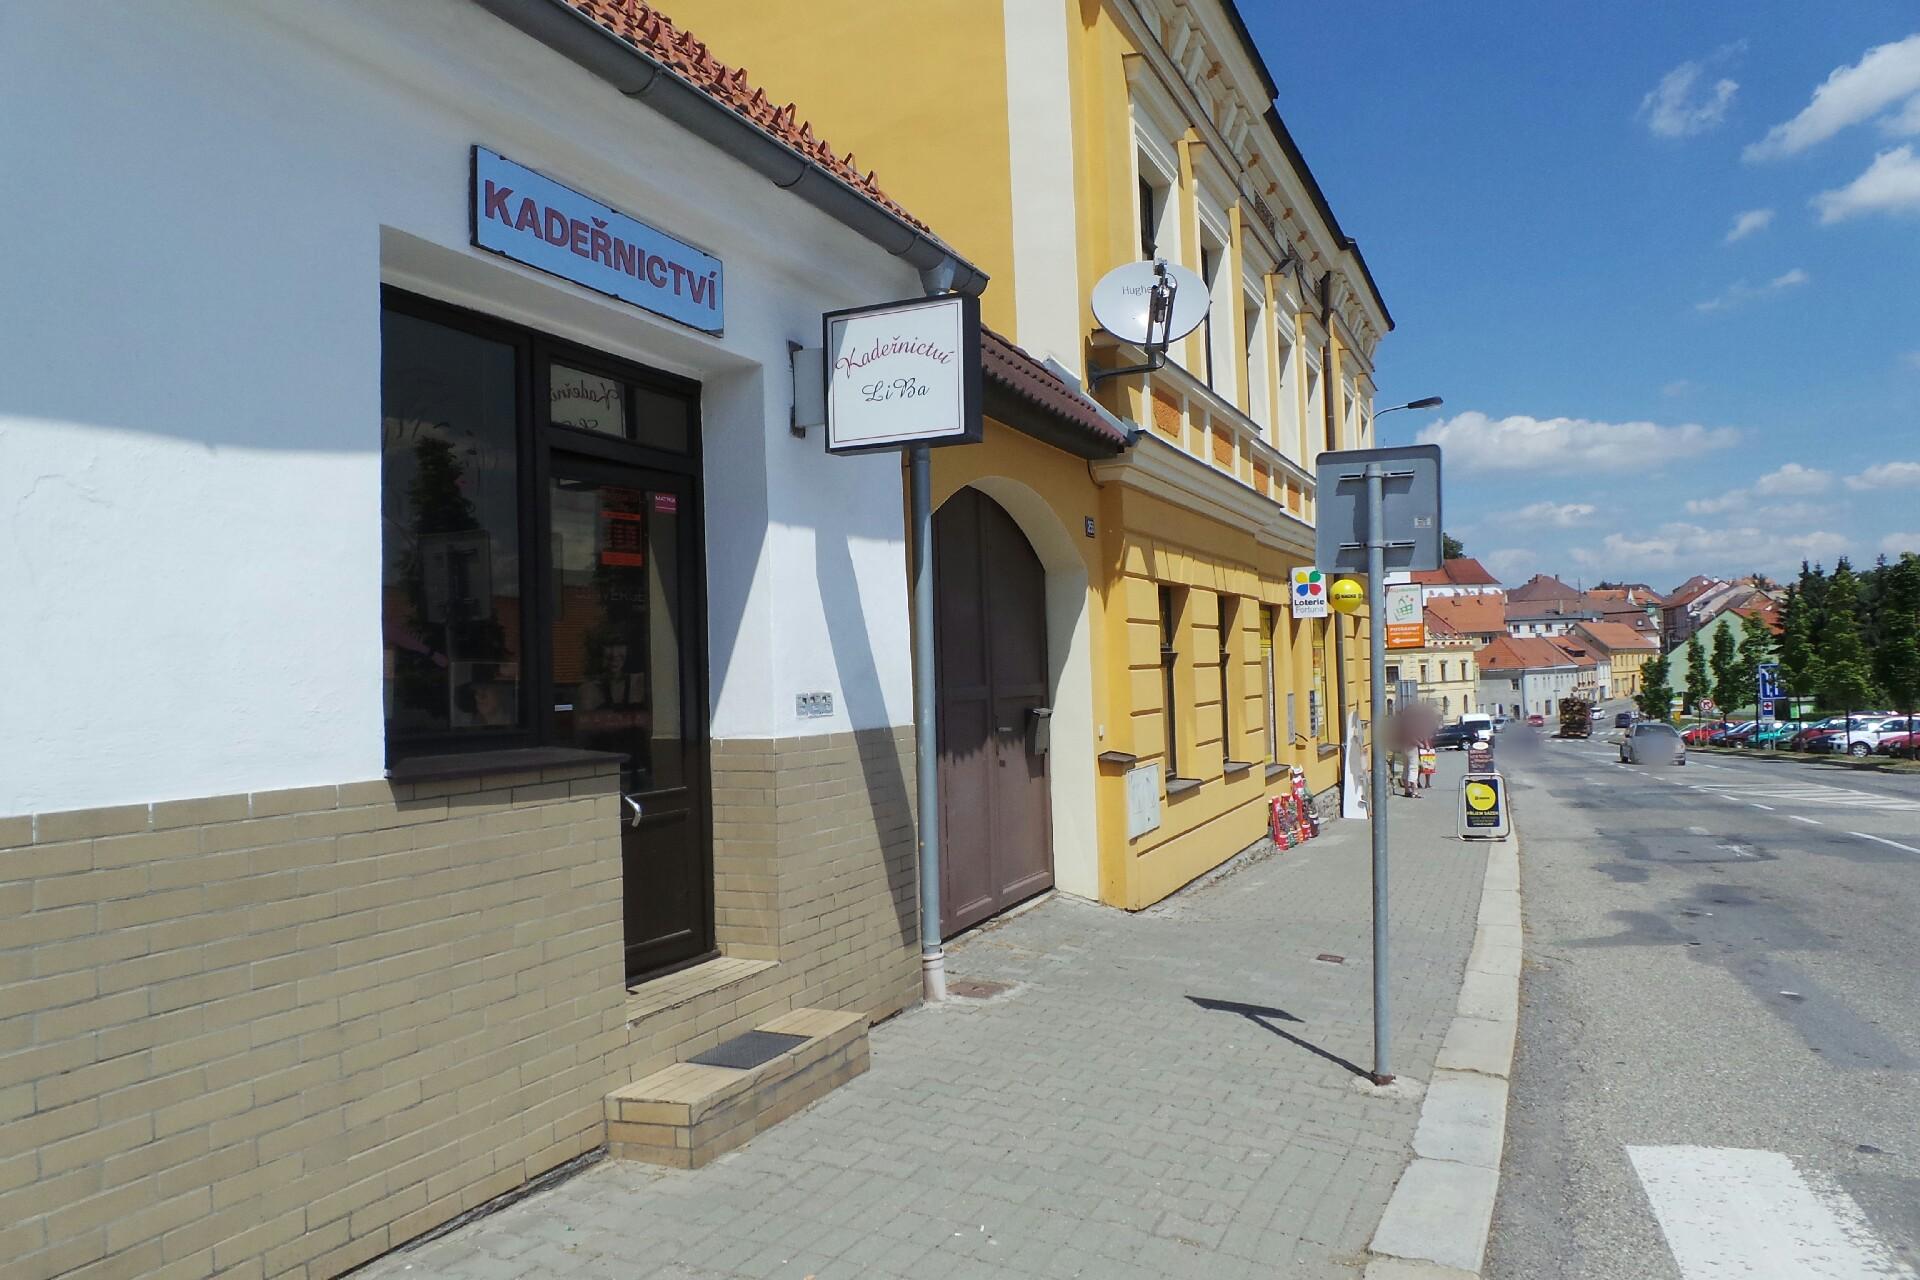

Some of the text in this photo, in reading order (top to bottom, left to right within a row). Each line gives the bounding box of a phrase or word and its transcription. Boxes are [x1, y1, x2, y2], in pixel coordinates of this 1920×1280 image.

[485, 179, 717, 311] KADEŘNICTVÍ
[834, 335, 955, 379] Kadeřnictví
[1295, 606, 1324, 614] Fortuna
